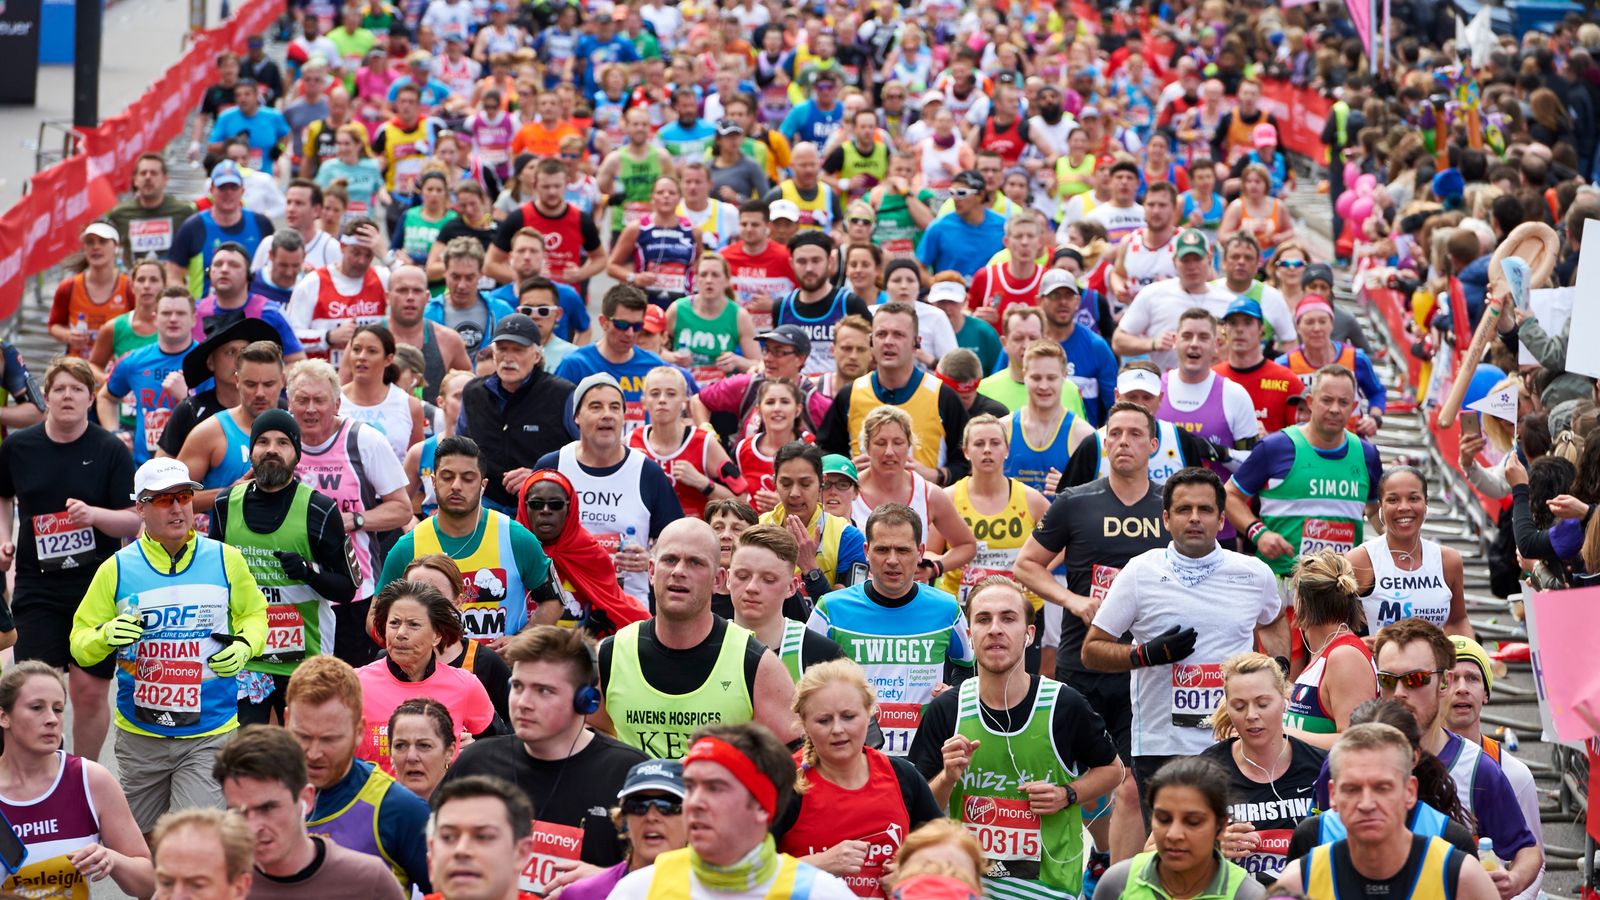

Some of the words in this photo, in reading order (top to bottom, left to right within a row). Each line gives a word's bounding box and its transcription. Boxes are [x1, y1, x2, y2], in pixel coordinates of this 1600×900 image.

[679, 328, 731, 350] AMY
[1260, 379, 1289, 392] MIKE
[1149, 465, 1174, 480] tch
[1309, 478, 1359, 498] SIMON
[576, 491, 622, 507] ONY
[1103, 516, 1161, 538] DON
[38, 529, 93, 555] 12239
[248, 558, 281, 567] ildren
[1379, 576, 1443, 590] GEMMA
[267, 611, 299, 620] money
[1378, 600, 1412, 621] MS
[463, 612, 505, 635] AM
[266, 628, 303, 649] 424
[137, 641, 200, 658] ADRIAN
[851, 638, 935, 662] TWIGGY
[164, 667, 200, 678] money
[868, 676, 904, 687] eimer's
[1204, 670, 1224, 679] mon
[135, 683, 199, 707] 40243
[877, 688, 903, 701] ciety
[626, 710, 666, 724] HAVENS
[669, 711, 721, 726] HOSPICES
[883, 710, 918, 722] money
[636, 731, 691, 760] KE
[885, 730, 908, 752] 11
[967, 797, 995, 823] Virgin
[998, 808, 1036, 822] money
[1226, 798, 1313, 823] CHRISTIN
[12, 818, 59, 838] OPHIE
[533, 831, 580, 852] money
[966, 826, 1038, 856] 0315
[1262, 838, 1289, 848] mon
[12, 870, 84, 889] Farleigh
[521, 856, 557, 887] 40
[987, 870, 1011, 878] adidas
[845, 876, 880, 890] money
